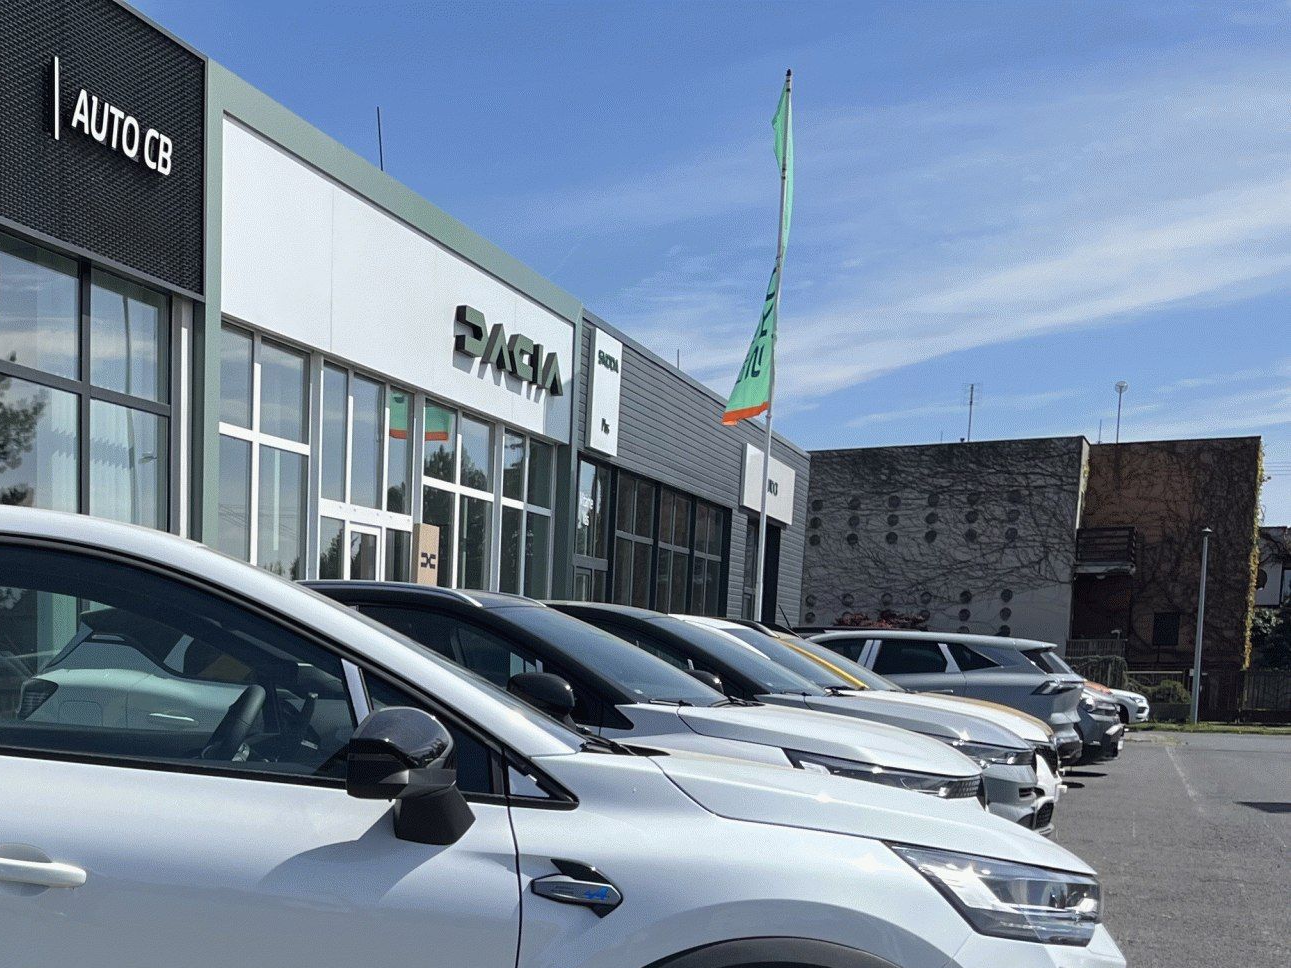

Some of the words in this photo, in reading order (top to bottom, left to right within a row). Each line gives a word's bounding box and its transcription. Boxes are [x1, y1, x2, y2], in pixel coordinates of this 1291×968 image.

[71, 88, 140, 158] AUTO
[144, 128, 173, 176] CB
[454, 304, 564, 397] DACIA
